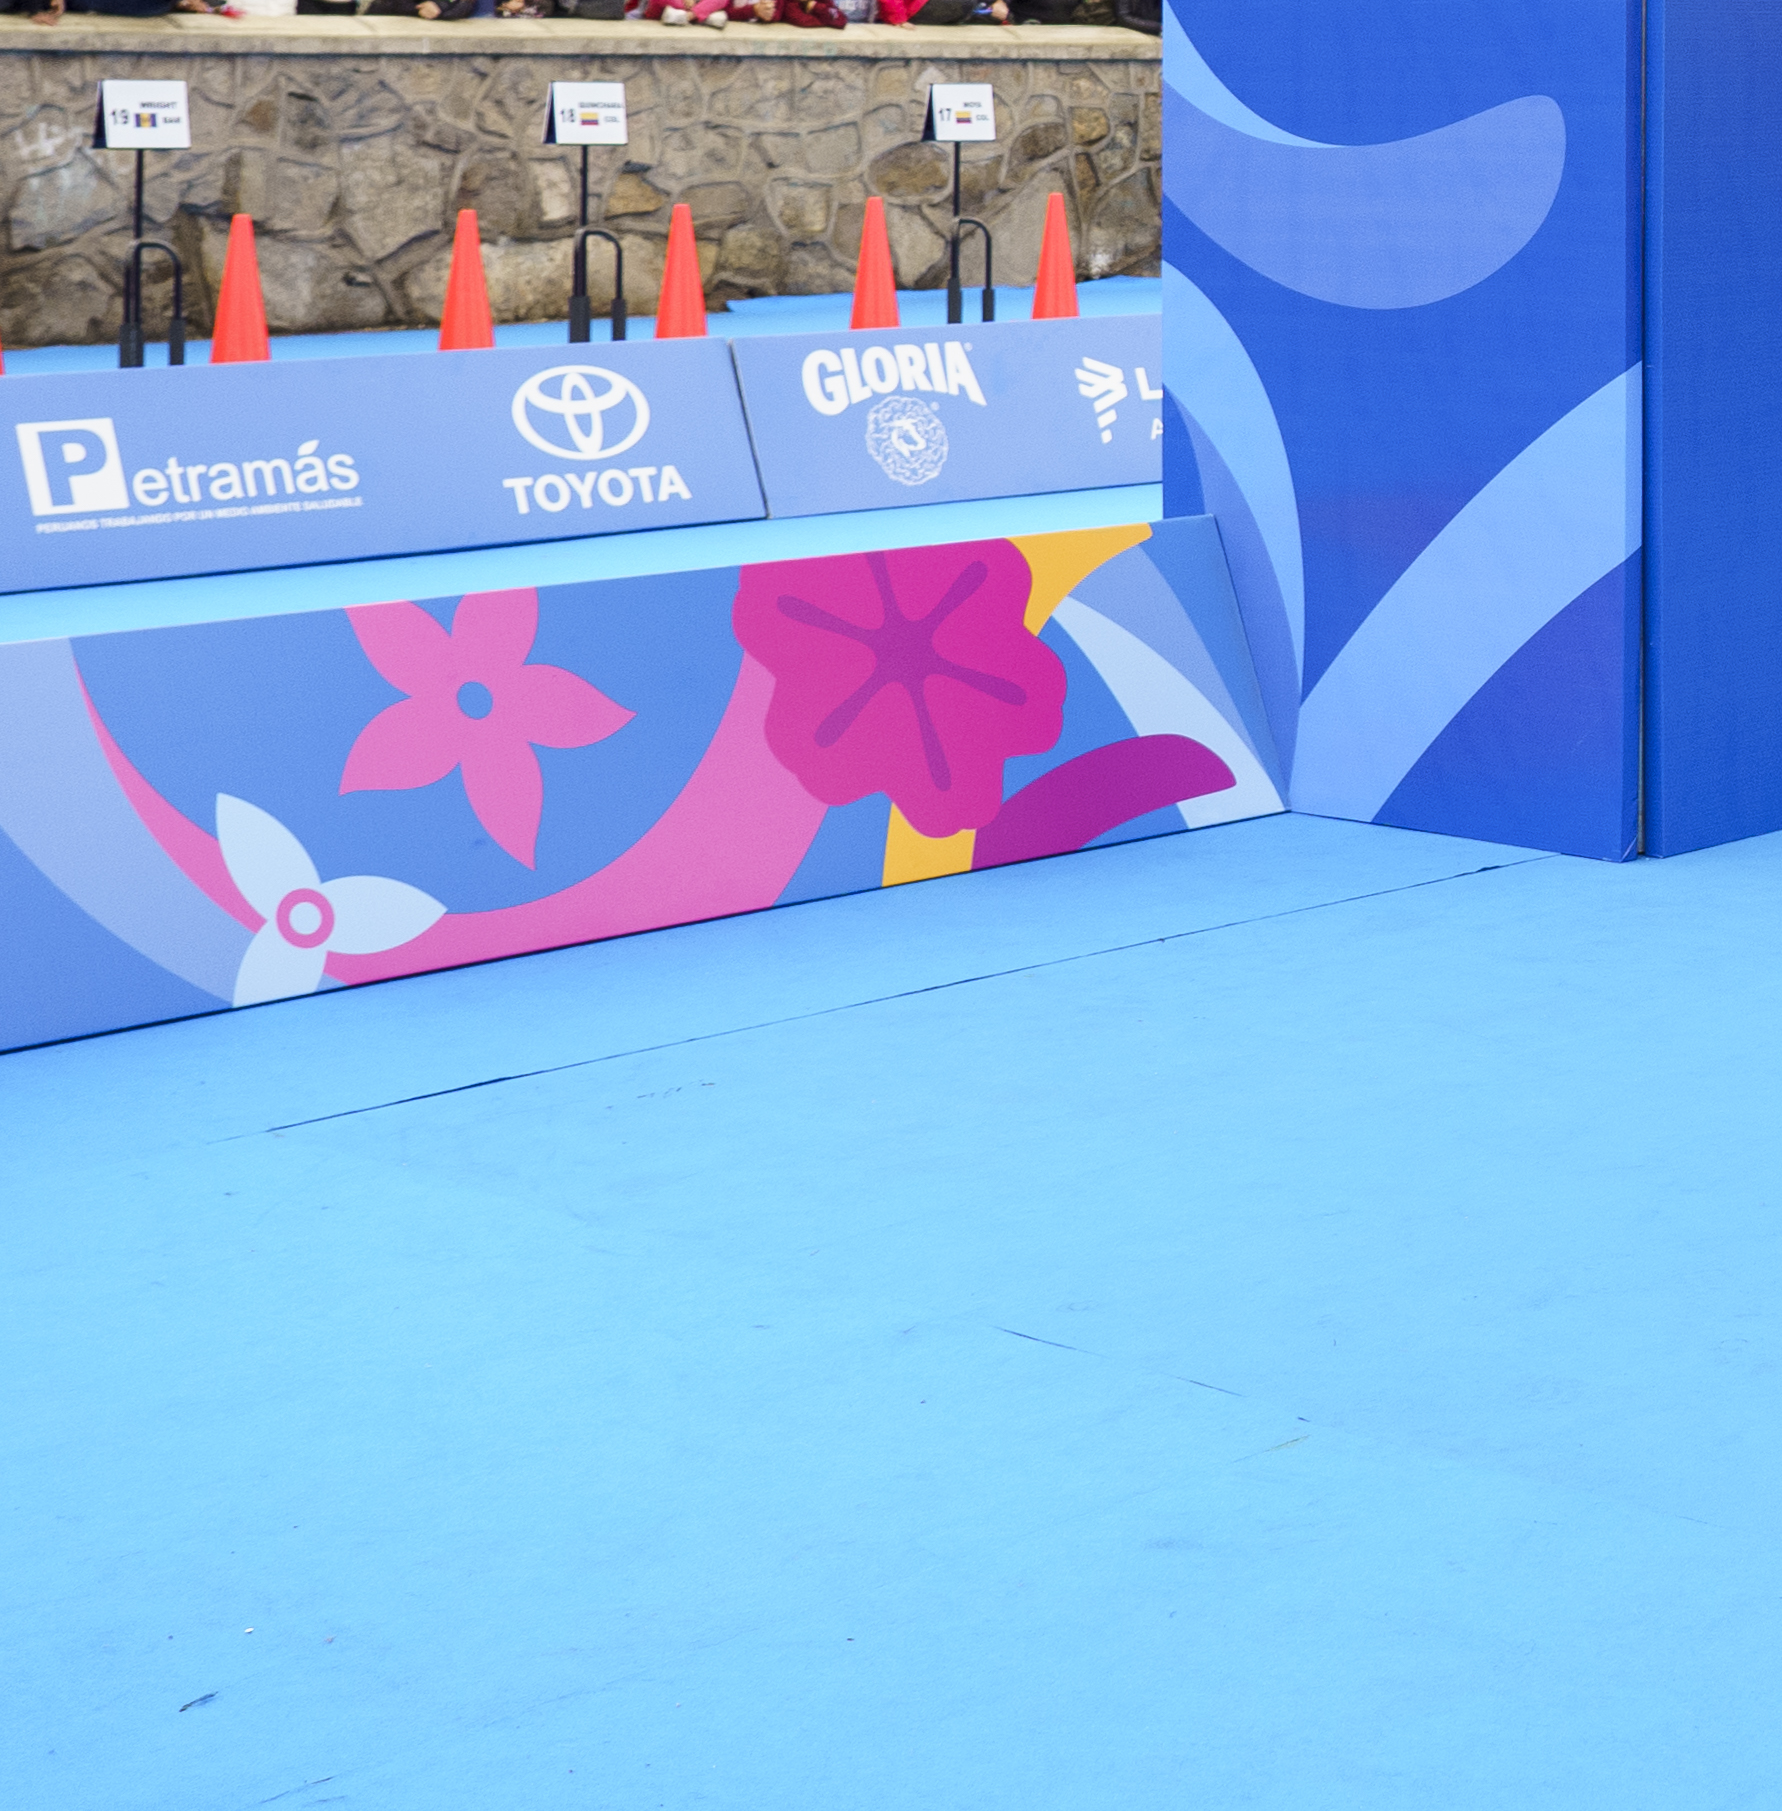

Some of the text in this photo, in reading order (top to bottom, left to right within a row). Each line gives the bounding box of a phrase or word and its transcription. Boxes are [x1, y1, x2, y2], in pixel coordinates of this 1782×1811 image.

[110, 109, 131, 125] 19
[560, 108, 576, 123] 18
[938, 107, 952, 122] 17
[802, 342, 988, 416] GLORIA
[15, 417, 361, 516] Petramás
[502, 464, 693, 515] TOYOTA
